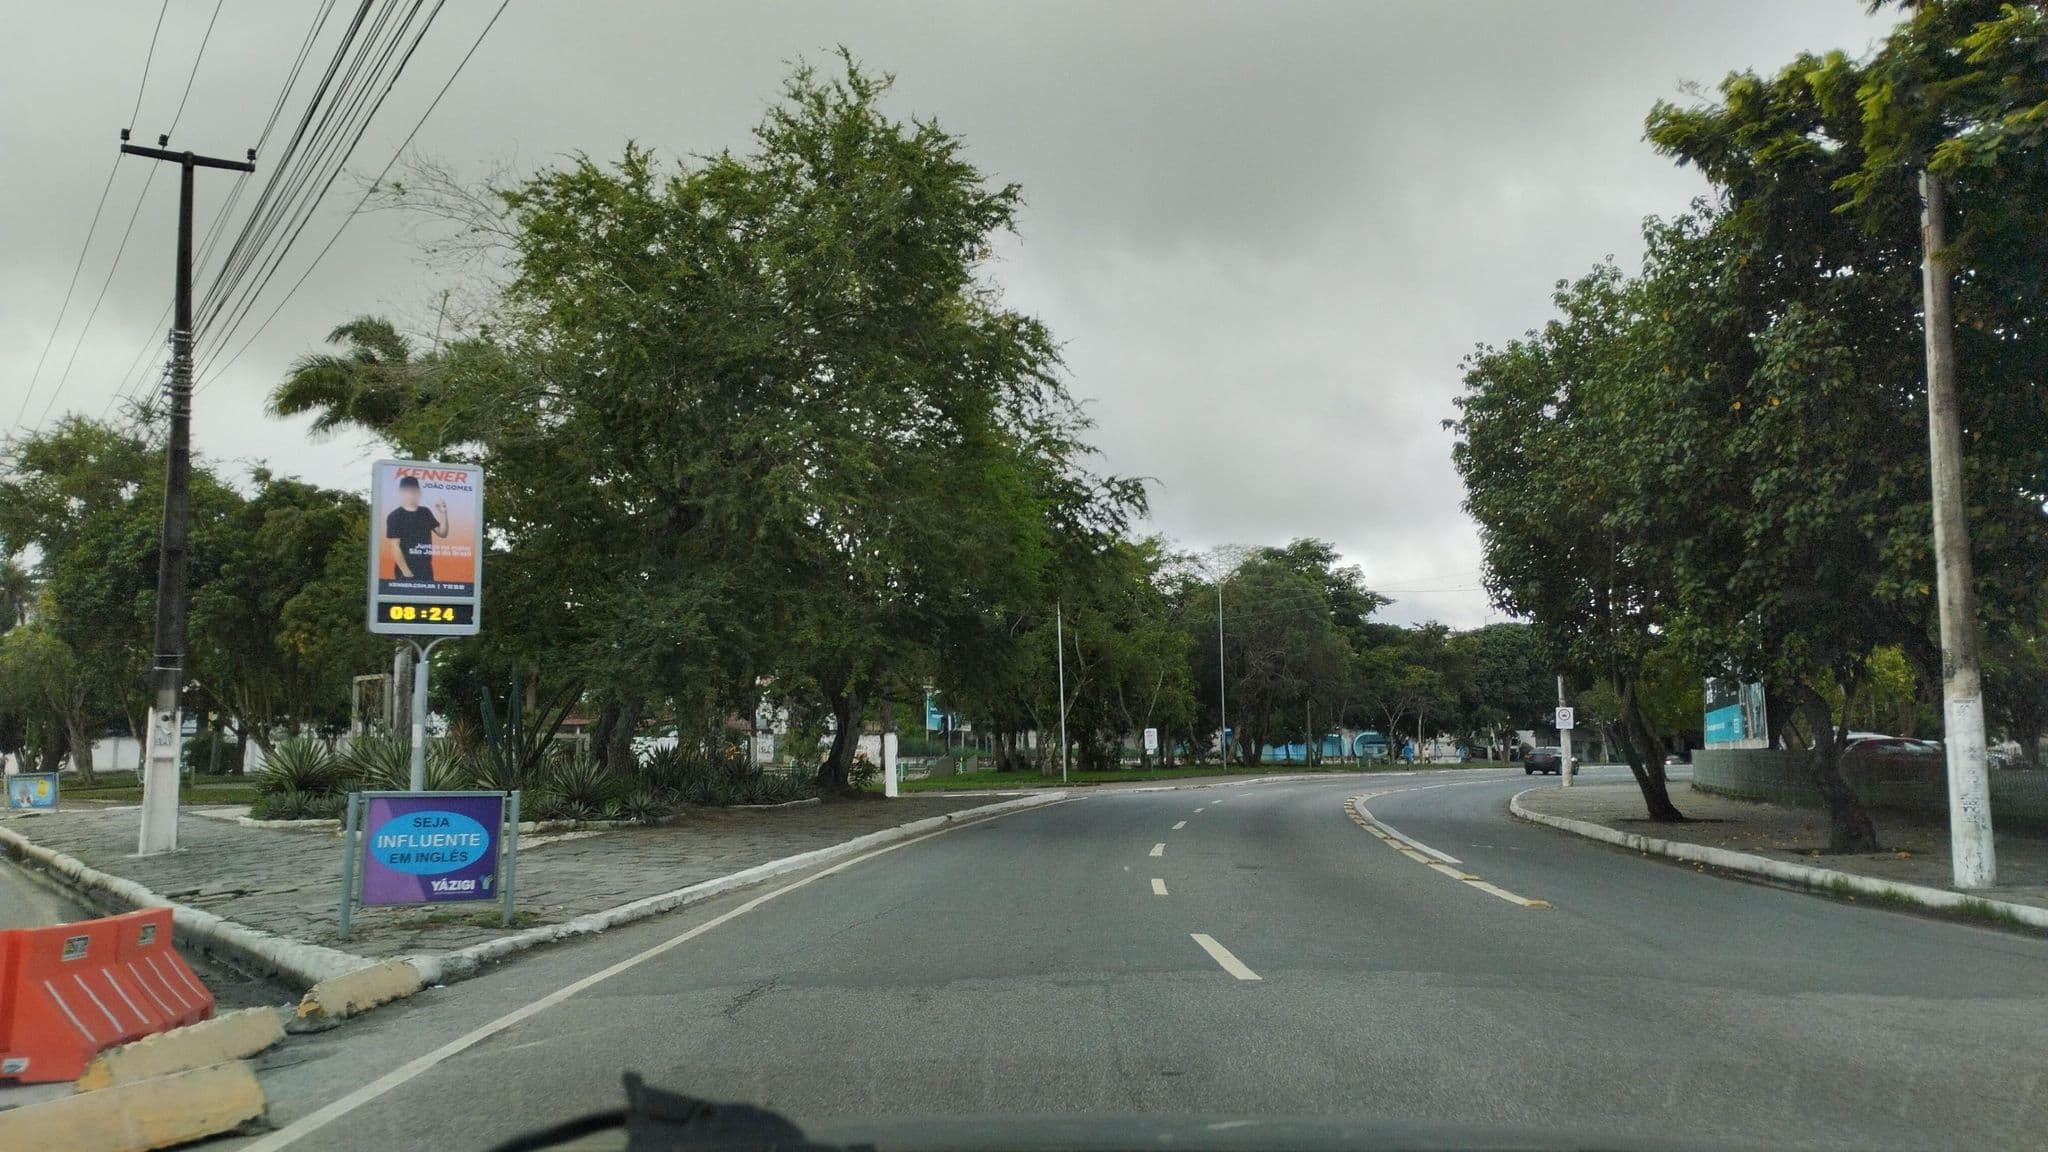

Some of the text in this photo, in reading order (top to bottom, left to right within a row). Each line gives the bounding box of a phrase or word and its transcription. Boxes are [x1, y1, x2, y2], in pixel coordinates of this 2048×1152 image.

[394, 467, 468, 483] KENNER
[422, 482, 444, 490] JOÃO
[389, 606, 455, 621] 08:24
[412, 817, 450, 828] SEJA
[377, 833, 481, 849] INFLUENTE
[389, 849, 469, 865] EM INGLÊS
[430, 878, 476, 892] YÁZIGI
